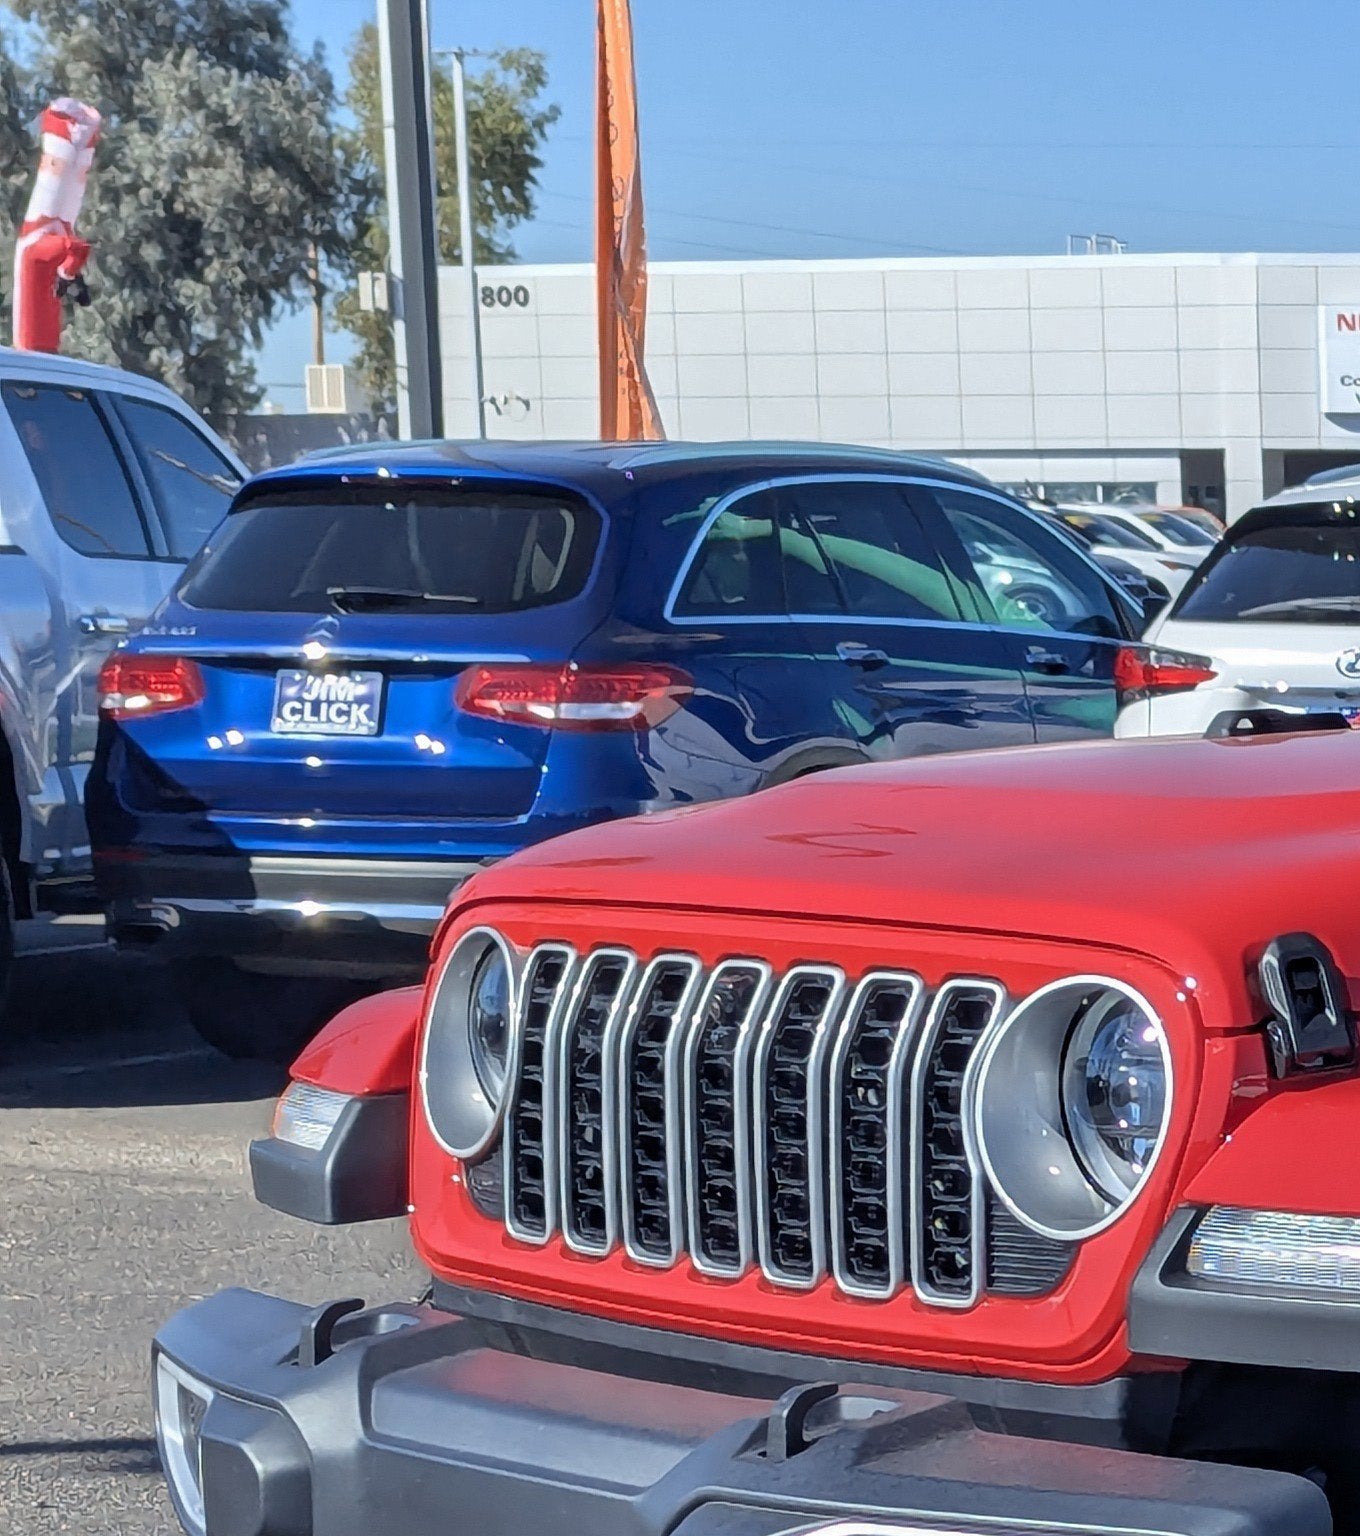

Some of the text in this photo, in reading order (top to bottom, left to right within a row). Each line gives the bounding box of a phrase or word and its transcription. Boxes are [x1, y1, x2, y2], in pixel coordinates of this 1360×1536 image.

[481, 285, 530, 308] 800
[302, 674, 356, 701] JIM
[281, 701, 372, 725] CLICK
